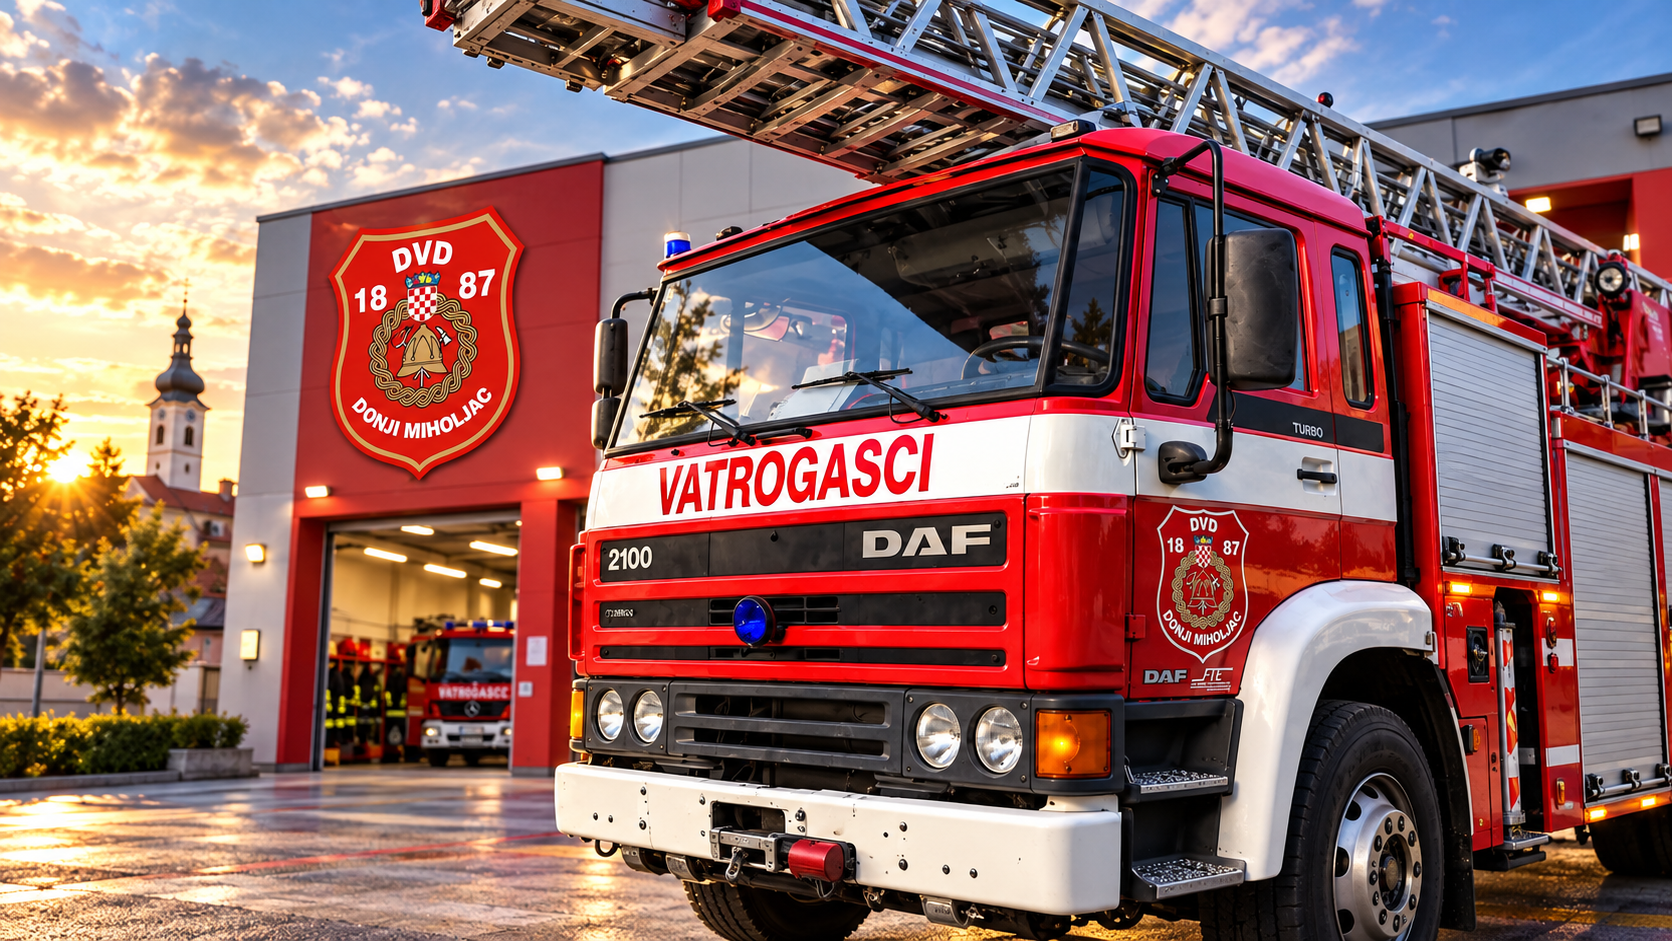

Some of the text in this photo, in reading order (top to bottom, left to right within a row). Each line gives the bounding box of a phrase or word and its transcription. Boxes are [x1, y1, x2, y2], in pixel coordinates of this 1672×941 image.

[392, 240, 453, 273] DVD
[354, 269, 495, 313] 18 87
[351, 387, 493, 439] DONJI MIHOLJAC
[1292, 421, 1324, 438] TURBO
[659, 433, 935, 515] VATROGASCI
[862, 523, 992, 559] DAF
[1190, 517, 1218, 533] DVD
[608, 546, 653, 571] 2100
[1167, 537, 1240, 556] 18 87
[1162, 609, 1242, 646] DONJI MIHOLJAC
[1144, 669, 1188, 684] DAF
